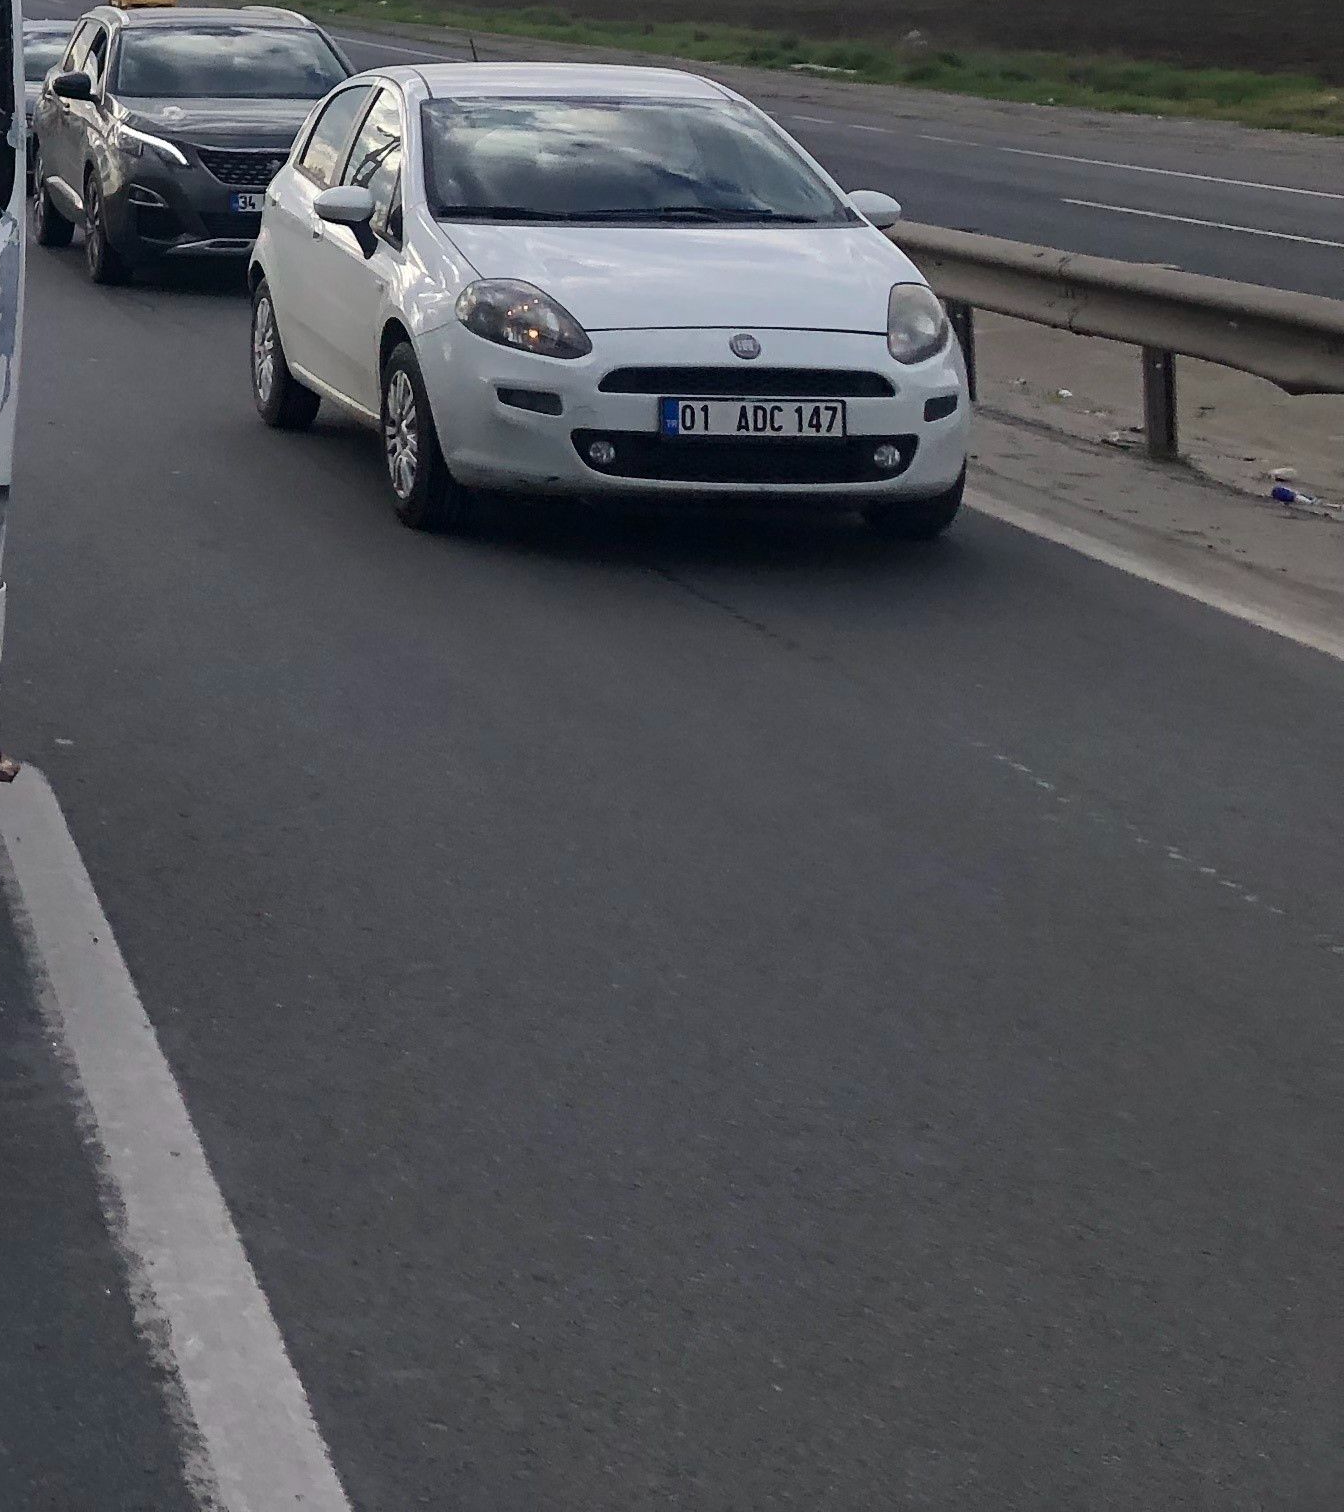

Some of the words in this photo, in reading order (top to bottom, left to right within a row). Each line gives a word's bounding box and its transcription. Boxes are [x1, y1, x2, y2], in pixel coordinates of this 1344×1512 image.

[239, 195, 256, 209] 34
[681, 404, 709, 431] 01
[736, 405, 783, 432] ADC
[794, 406, 838, 433] 147
